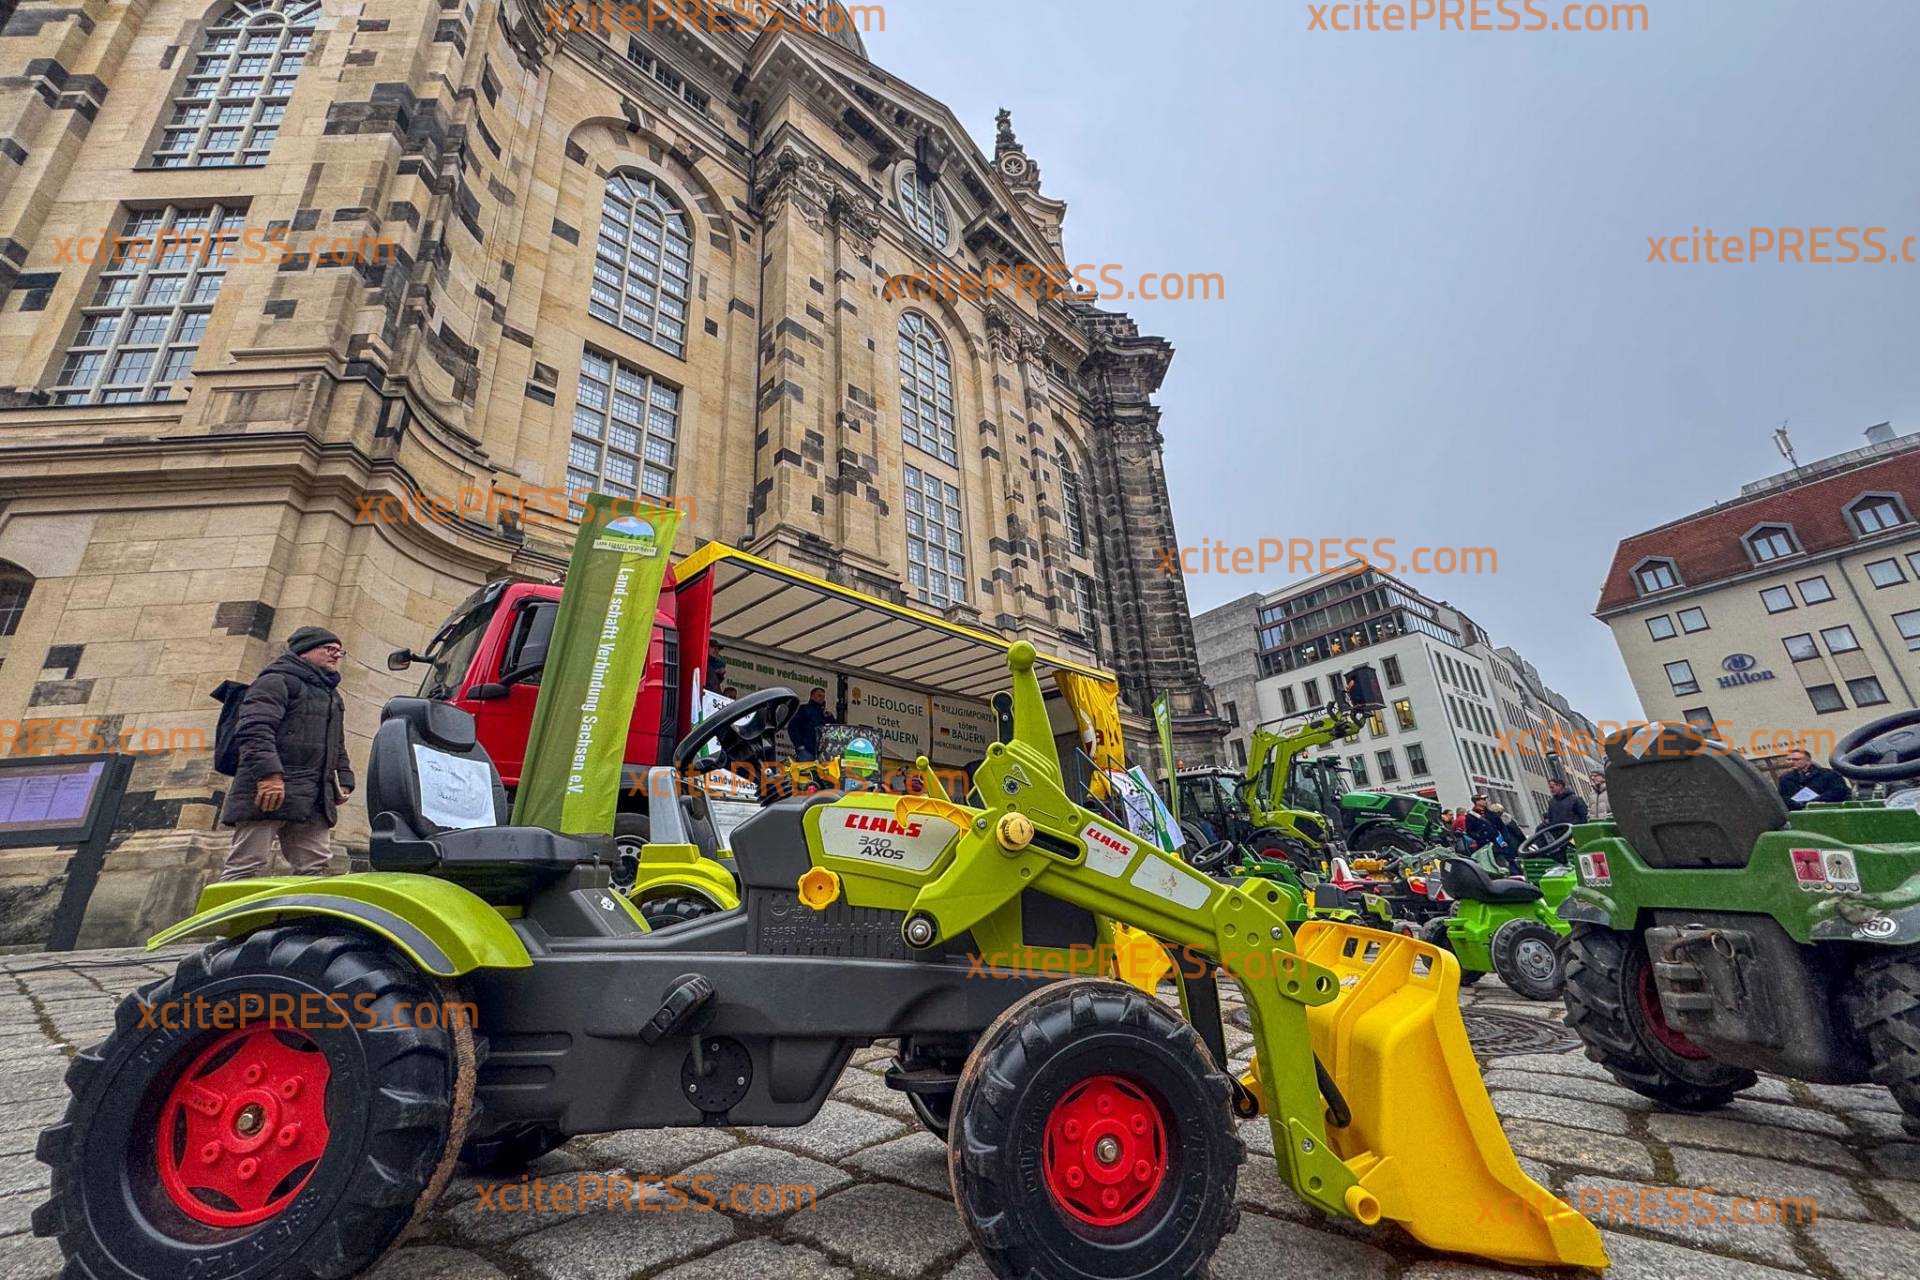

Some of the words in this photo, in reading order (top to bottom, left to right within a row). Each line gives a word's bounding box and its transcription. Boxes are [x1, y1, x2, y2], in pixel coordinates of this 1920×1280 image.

[613, 566, 634, 595] Land
[581, 642, 615, 712] Verbindung
[777, 667, 829, 688] verhandeln
[1717, 670, 1775, 688] Hilton
[877, 714, 900, 728] tötet
[571, 715, 598, 771] Sachsen
[951, 728, 986, 744] BAUERN
[845, 814, 922, 838] CLAAS
[858, 835, 892, 849] 340
[1086, 827, 1131, 856] CLAAS
[860, 845, 905, 860] AXOS
